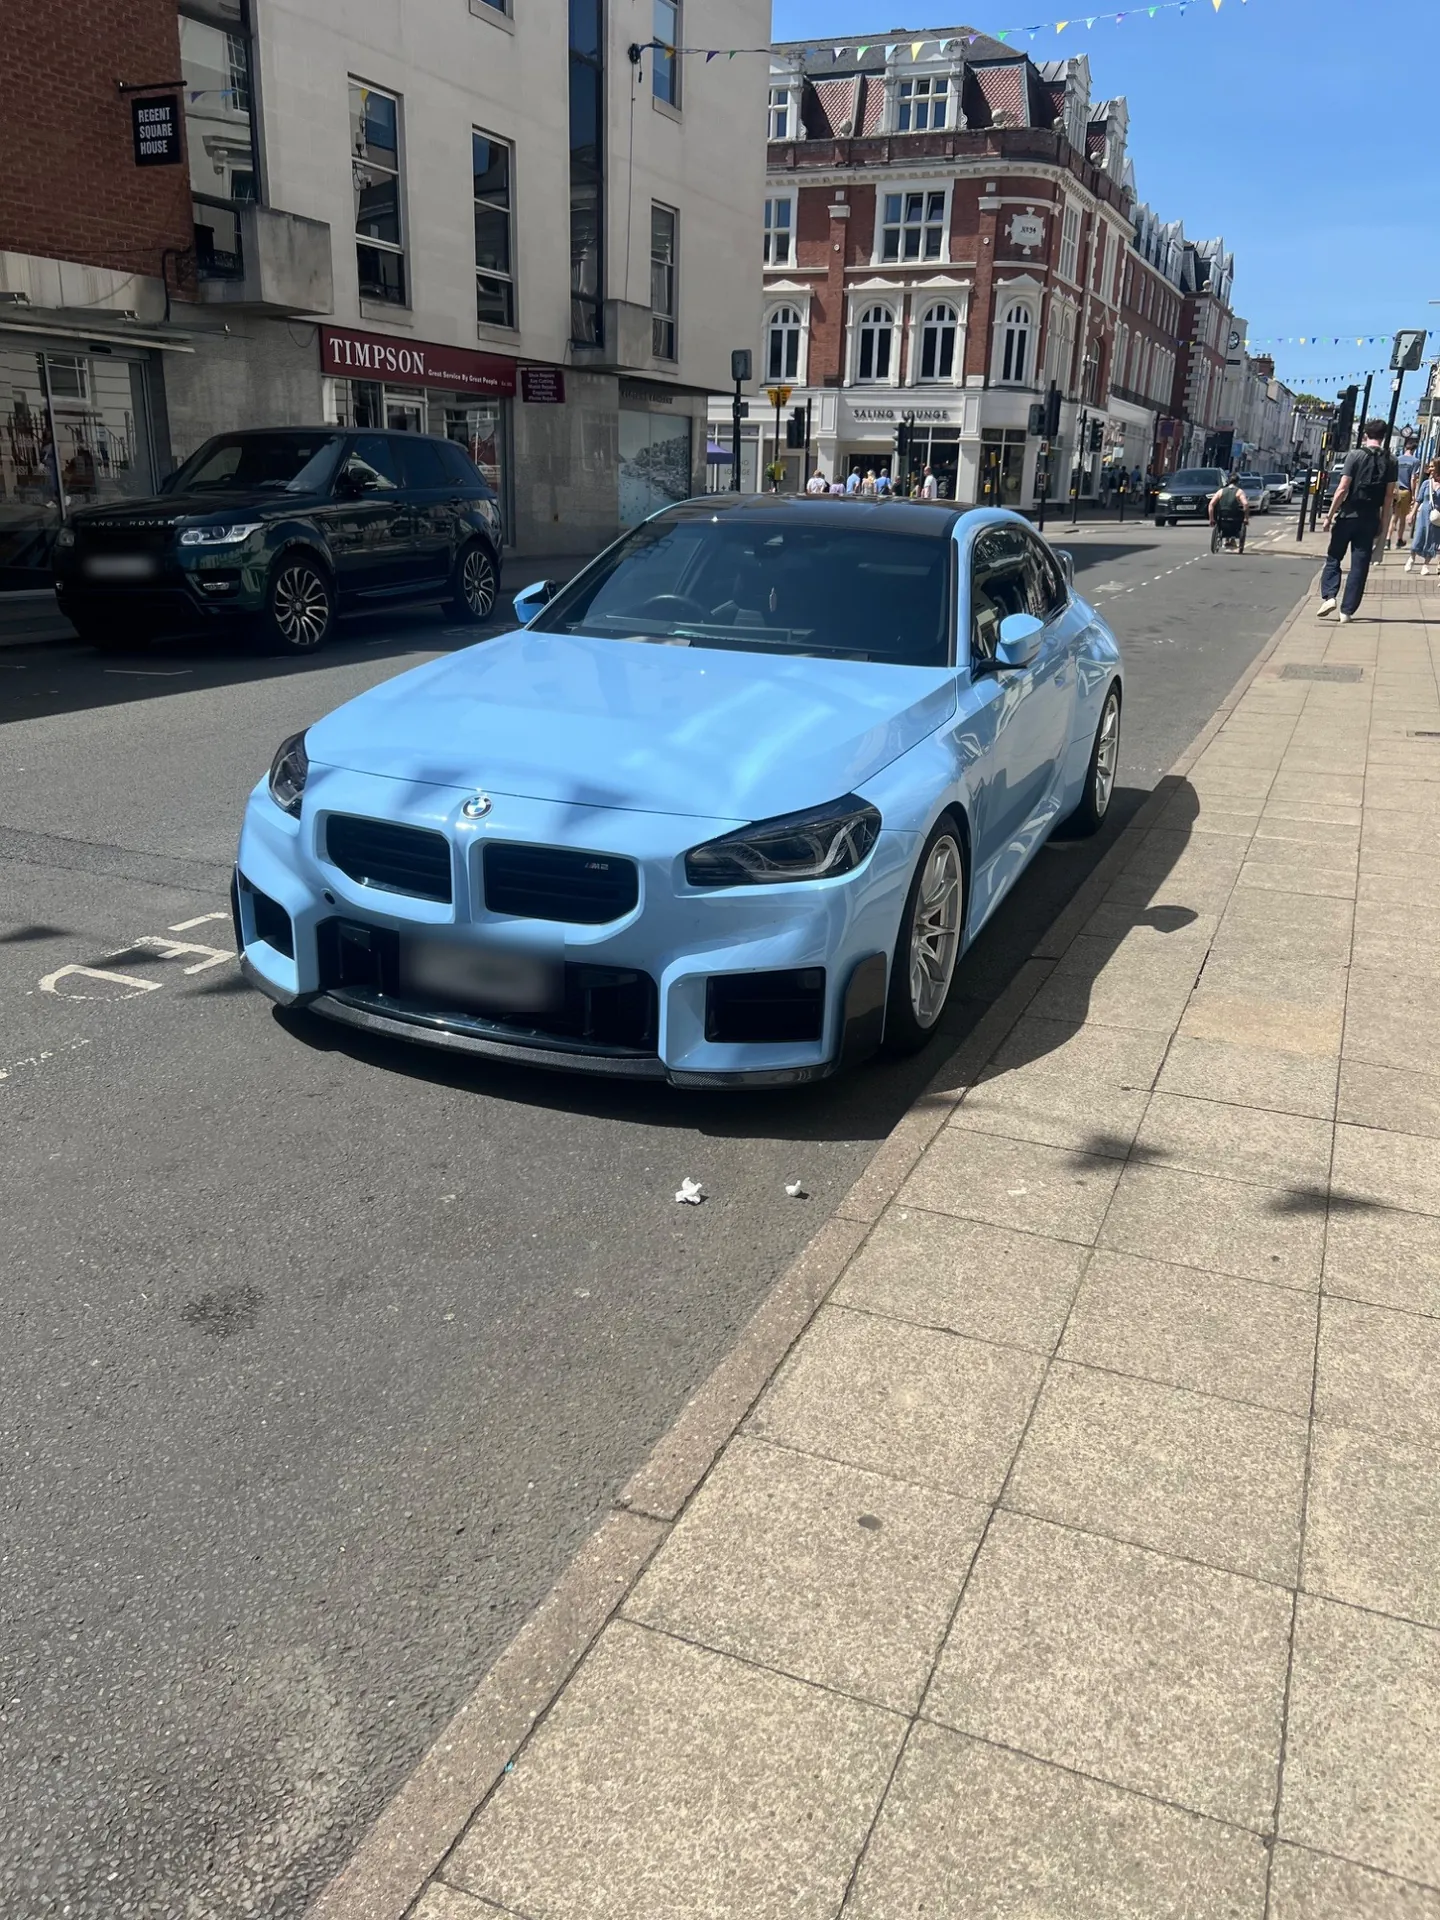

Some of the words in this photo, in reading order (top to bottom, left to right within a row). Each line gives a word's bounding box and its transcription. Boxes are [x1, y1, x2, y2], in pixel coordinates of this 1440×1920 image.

[138, 107, 170, 123] REGENT
[139, 123, 173, 139] SQUARE
[140, 140, 168, 155] HOUSE
[329, 338, 424, 375] TIMPSON
[428, 369, 442, 377] Great
[443, 371, 460, 380] Service
[462, 374, 468, 382] By
[483, 377, 498, 385] People
[853, 409, 894, 419] SALINO
[901, 409, 948, 419] LOUNGE
